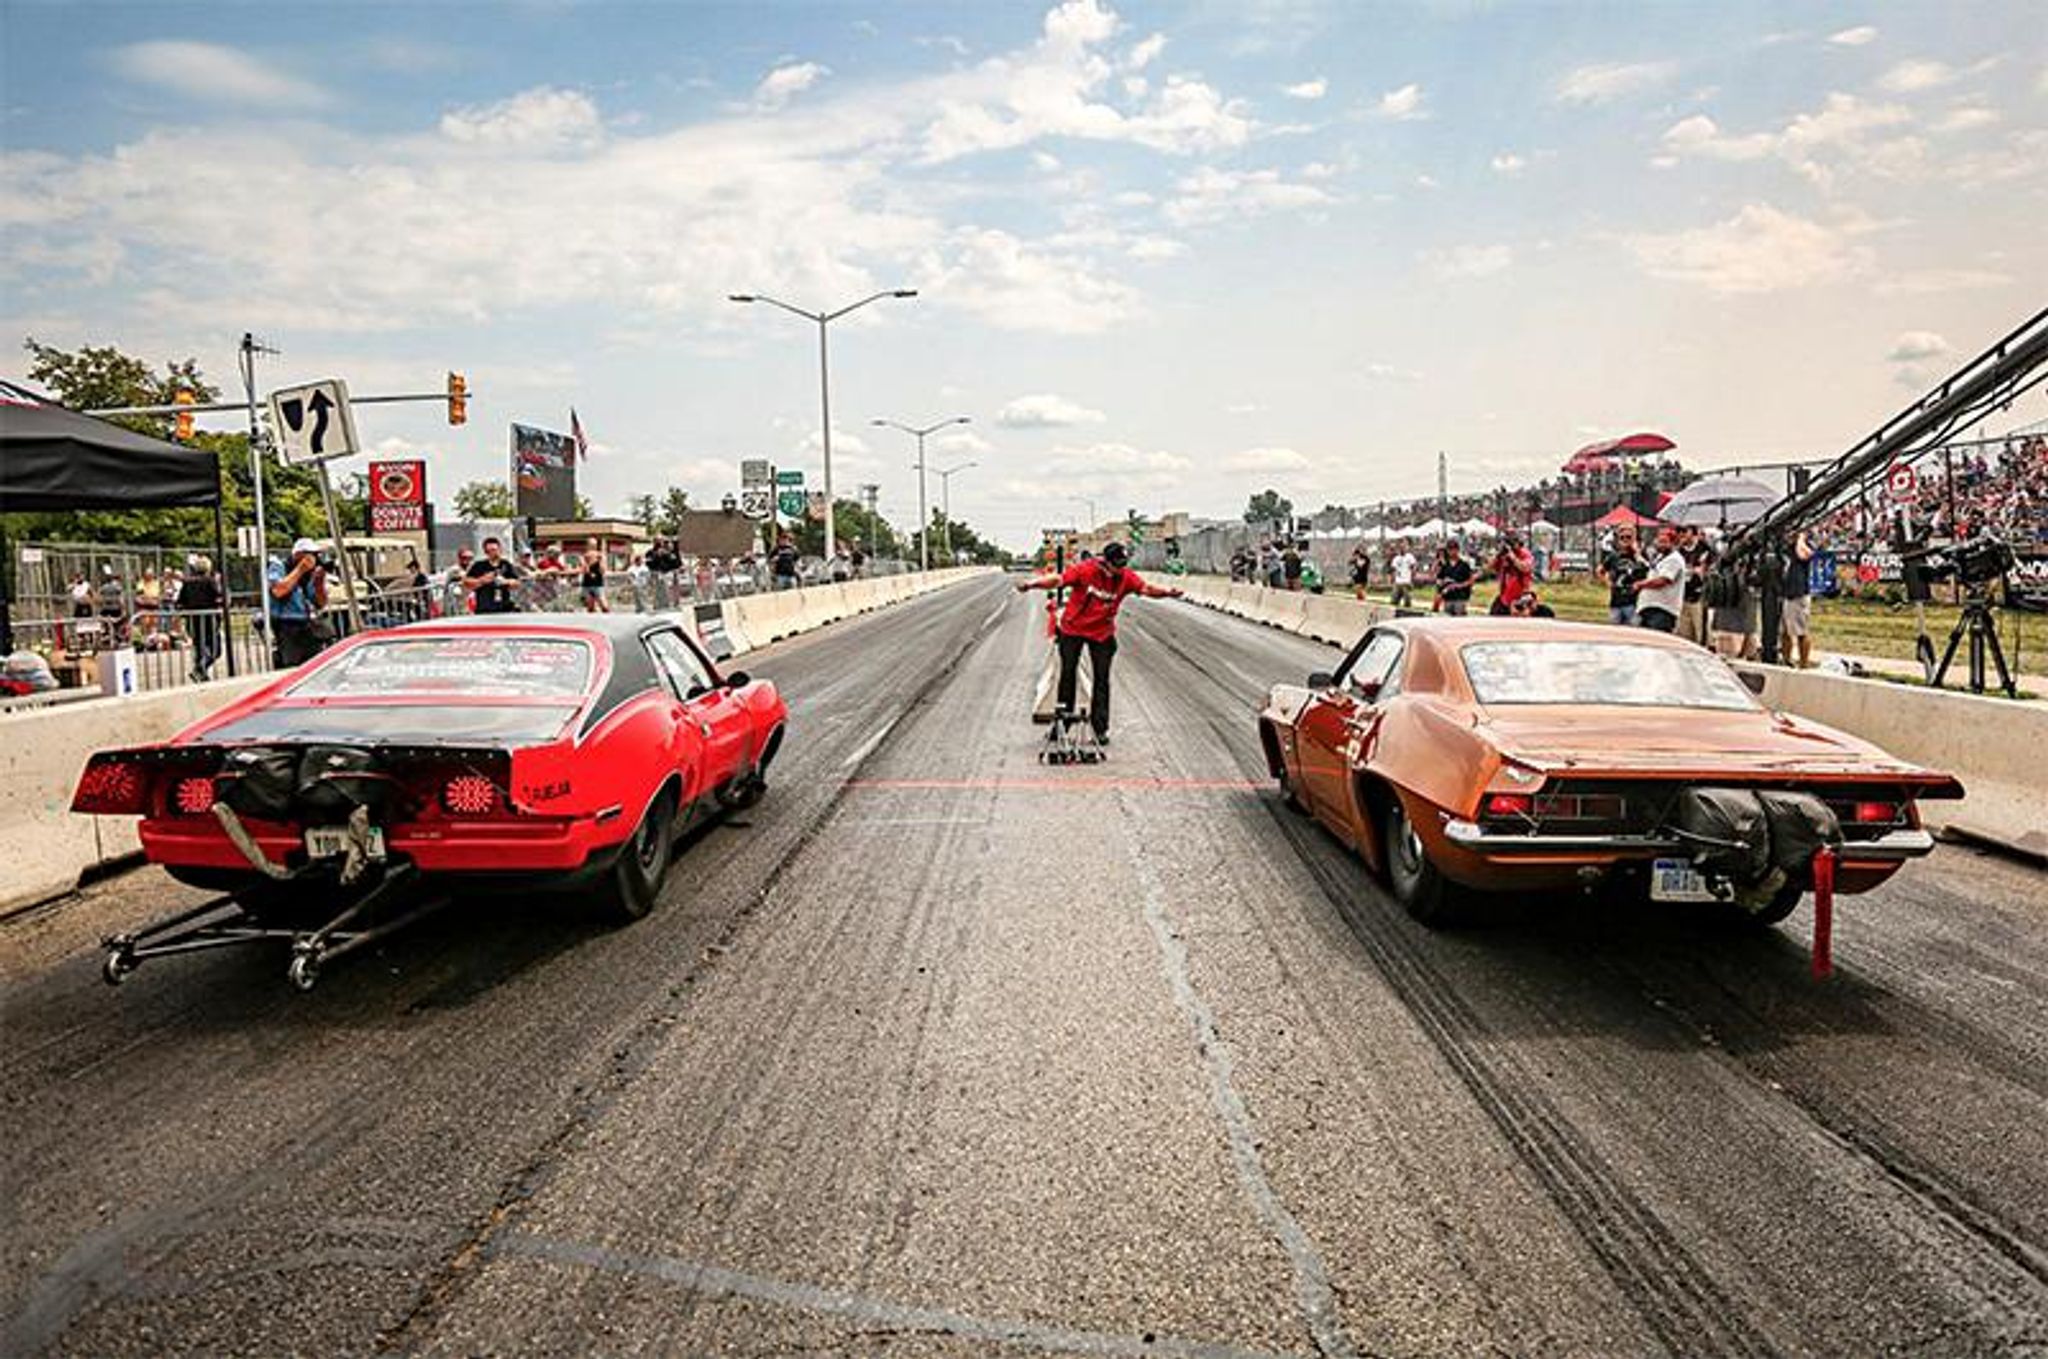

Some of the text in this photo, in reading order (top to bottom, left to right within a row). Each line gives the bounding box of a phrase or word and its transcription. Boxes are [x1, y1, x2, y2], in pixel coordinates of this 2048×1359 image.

[744, 497, 767, 513] 24
[372, 507, 423, 518] DONUTS
[374, 519, 420, 531] COFFEE
